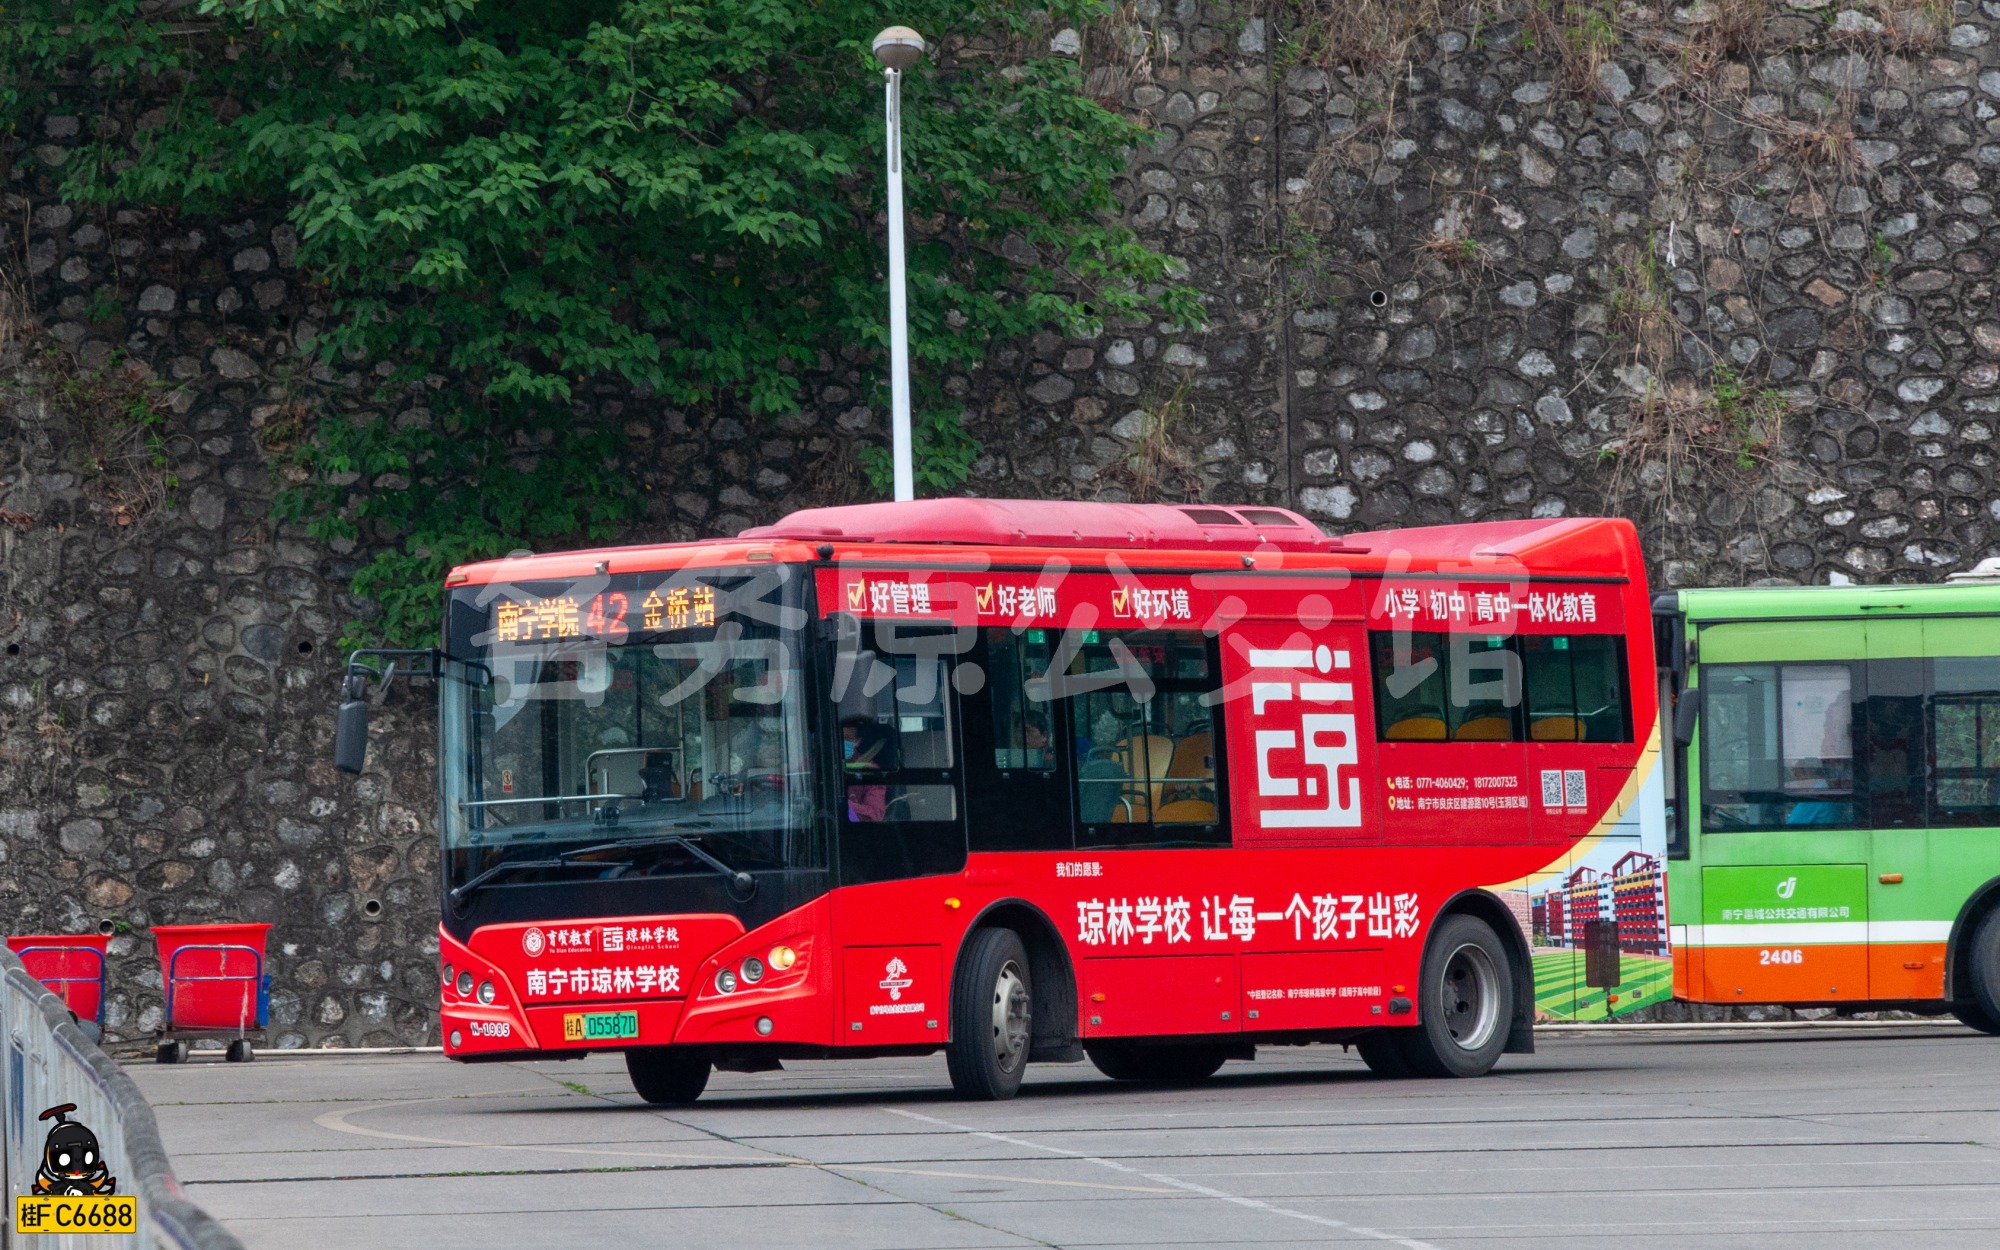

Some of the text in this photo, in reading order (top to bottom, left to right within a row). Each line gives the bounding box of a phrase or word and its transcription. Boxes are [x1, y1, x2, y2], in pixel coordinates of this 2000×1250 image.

[497, 586, 715, 641] 南宁学院 42 金桥站
[870, 581, 932, 615] 好管理
[997, 585, 1056, 618] 好老师
[1132, 588, 1191, 620] 好环境
[1384, 588, 1597, 624] 小学 初中 高中一体化教育
[626, 926, 680, 944] 琼林学校
[1077, 891, 1420, 946] 琼林学校 让每一个孩子出彩
[1760, 949, 1803, 965] 2406
[526, 964, 680, 997] 南宁市琼林学校
